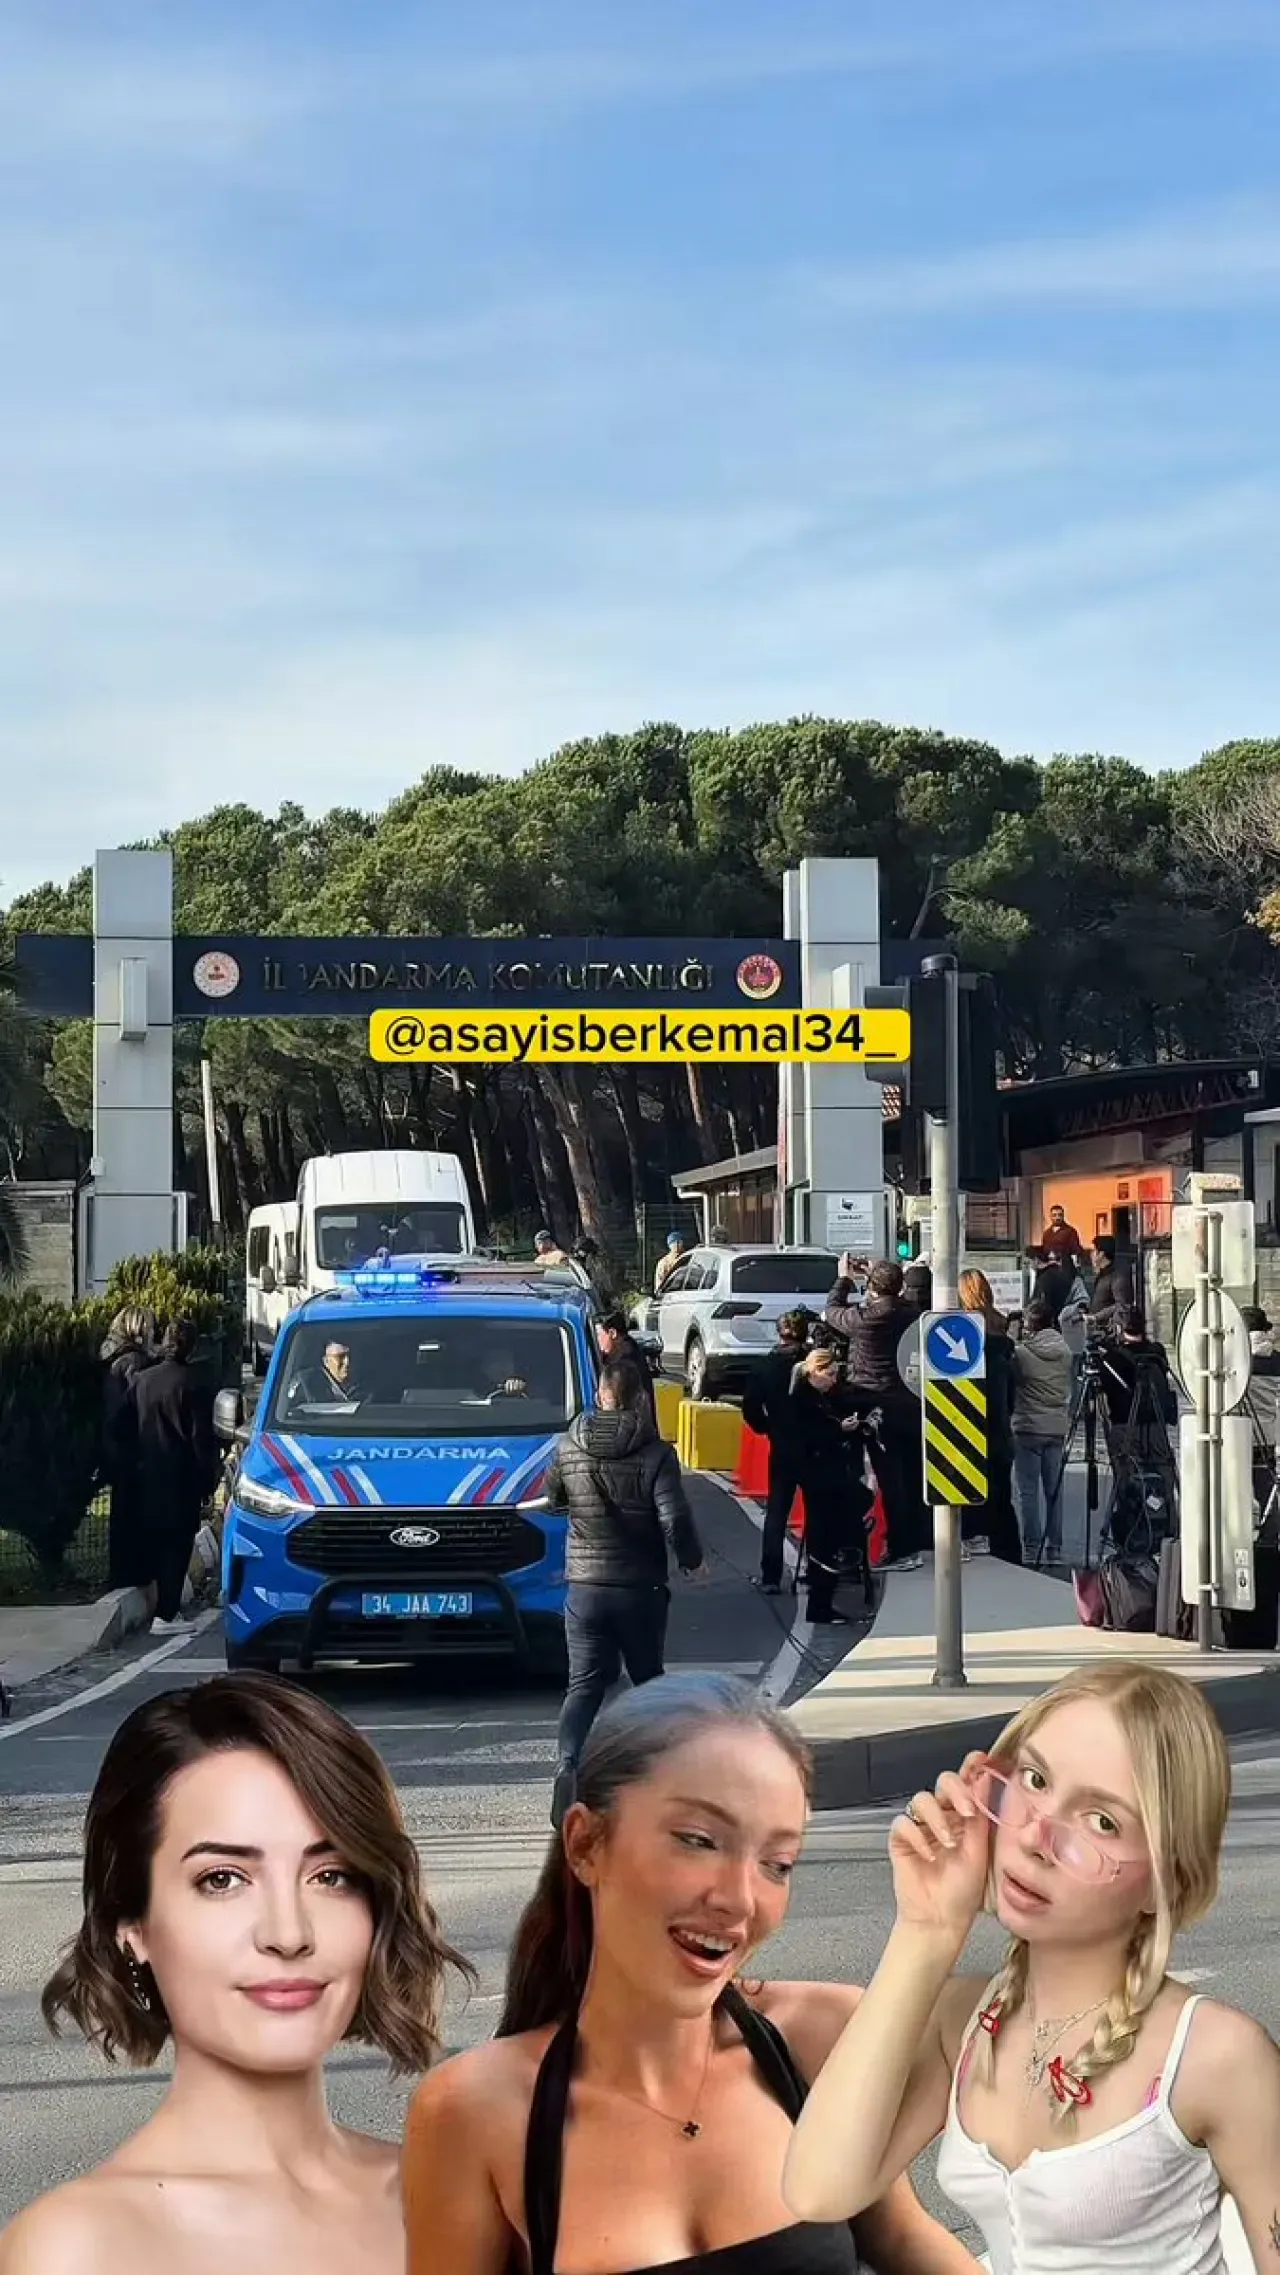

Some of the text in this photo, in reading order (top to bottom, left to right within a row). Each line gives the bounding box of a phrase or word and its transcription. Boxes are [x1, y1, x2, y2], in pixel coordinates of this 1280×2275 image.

[263, 956, 288, 990] İL
[327, 1446, 511, 1460] JANDARMA
[372, 1595, 468, 1613] 34 JAA 743
